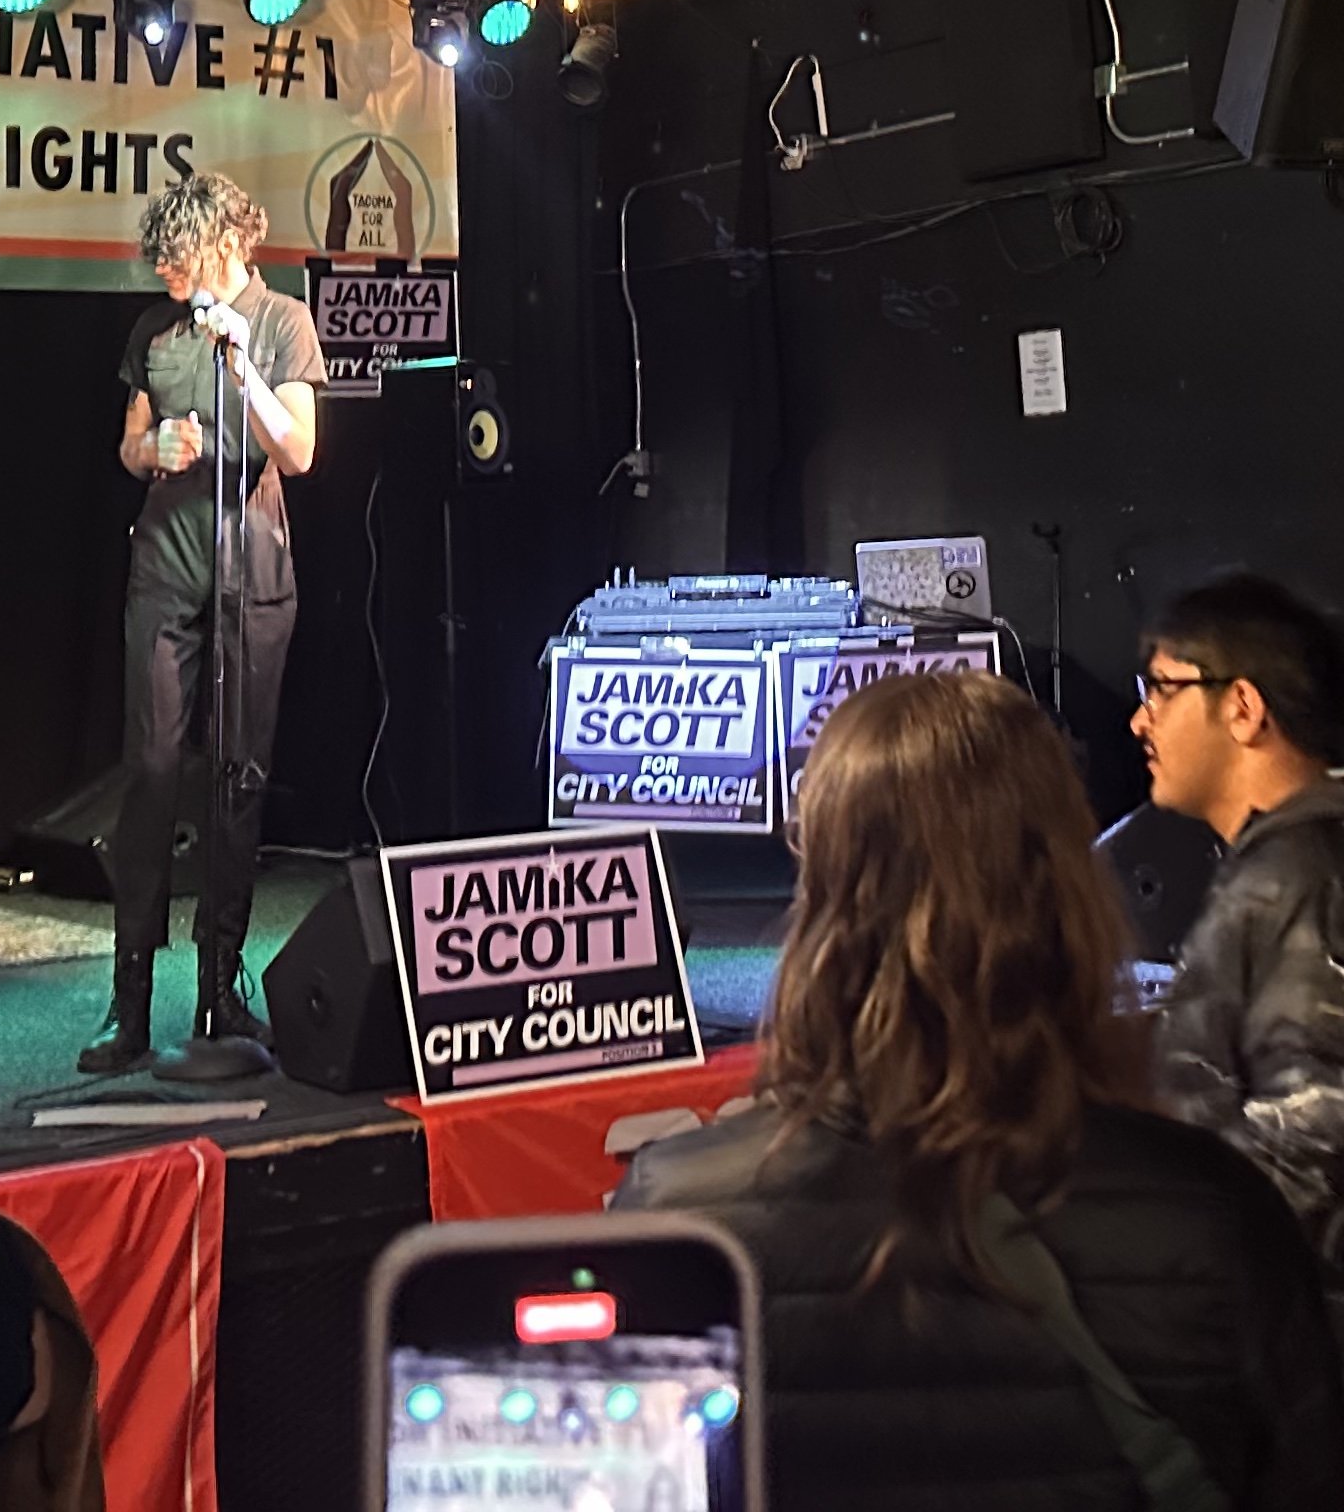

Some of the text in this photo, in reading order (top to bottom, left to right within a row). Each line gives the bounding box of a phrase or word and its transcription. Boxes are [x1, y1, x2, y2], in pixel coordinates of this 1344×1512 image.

[253, 25, 339, 101] #1
[352, 193, 394, 209] TACOMA
[361, 212, 383, 226] FOR
[358, 231, 386, 248] ALL
[326, 309, 440, 337] SCOTT
[372, 343, 398, 357] FOR
[325, 357, 364, 379] ITY
[576, 710, 742, 748] SCOTT
[640, 755, 679, 775] FOR
[556, 773, 628, 802] CITY
[631, 774, 763, 806] COUNCIL
[434, 906, 638, 981] SCOTT
[528, 980, 574, 1010] FOR
[424, 994, 686, 1066] CITY COUNCIL
